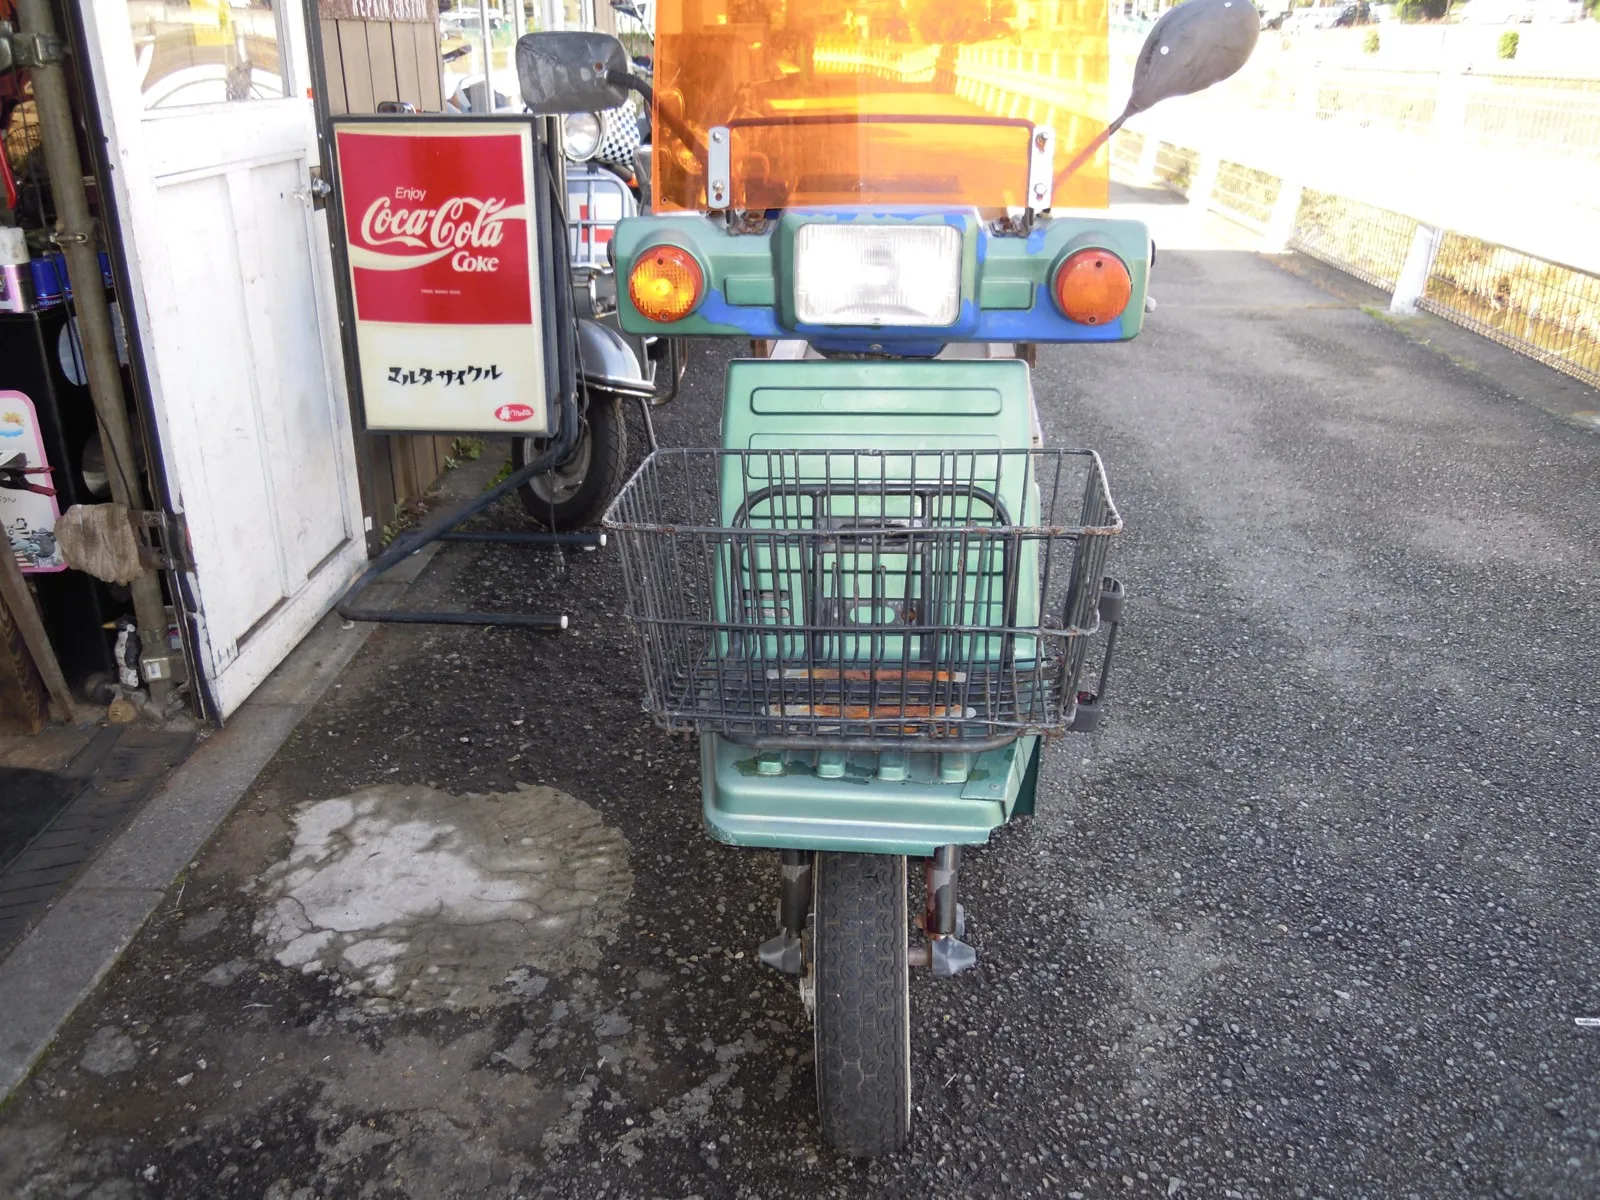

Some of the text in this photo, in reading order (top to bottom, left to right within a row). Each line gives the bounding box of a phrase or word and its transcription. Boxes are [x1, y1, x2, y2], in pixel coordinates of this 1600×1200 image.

[395, 186, 426, 201] Enjoy
[361, 196, 505, 249] Coca-Cola
[451, 251, 499, 272] Coke
[387, 364, 503, 387] マルタサイクル
